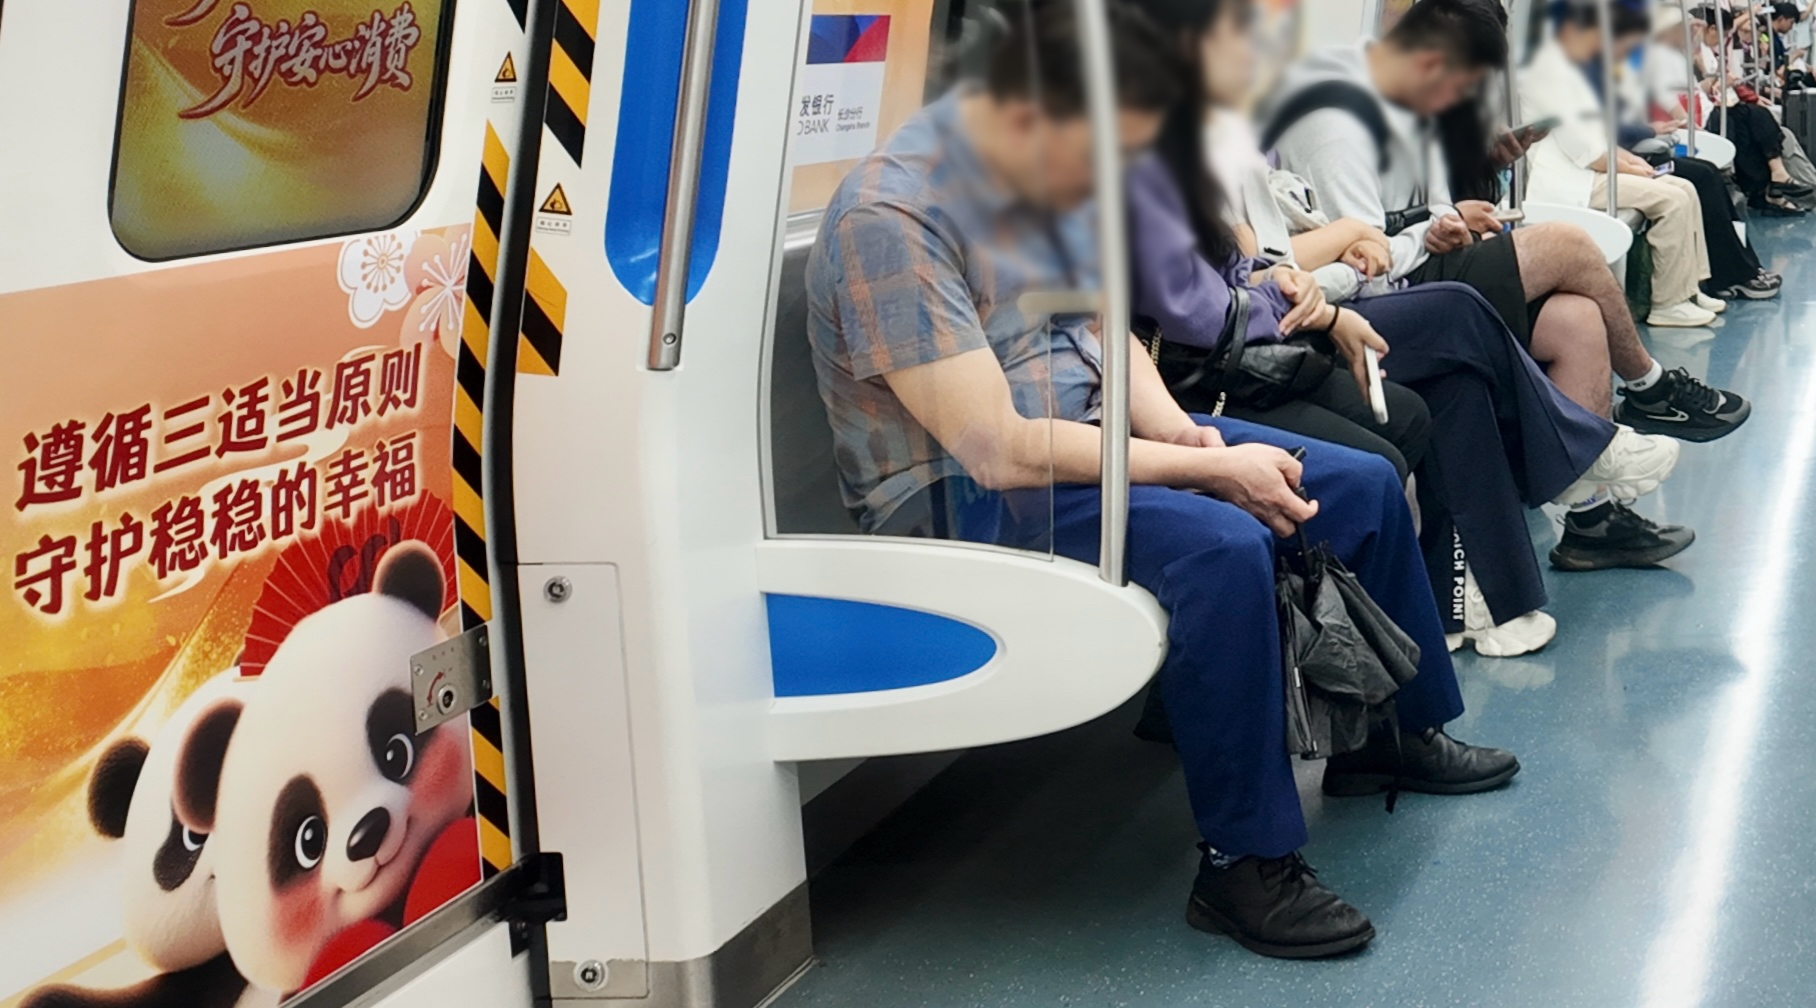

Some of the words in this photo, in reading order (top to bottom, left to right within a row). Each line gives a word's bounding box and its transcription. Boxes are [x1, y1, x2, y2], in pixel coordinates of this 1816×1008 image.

[179, 3, 419, 118] 守护安心消费
[797, 118, 829, 135] DBANK
[799, 93, 834, 117] 发银行
[15, 342, 422, 512] 遵循三适当原则
[14, 432, 417, 615] 守护稳稳的幸福
[1452, 576, 1465, 621] POINT
